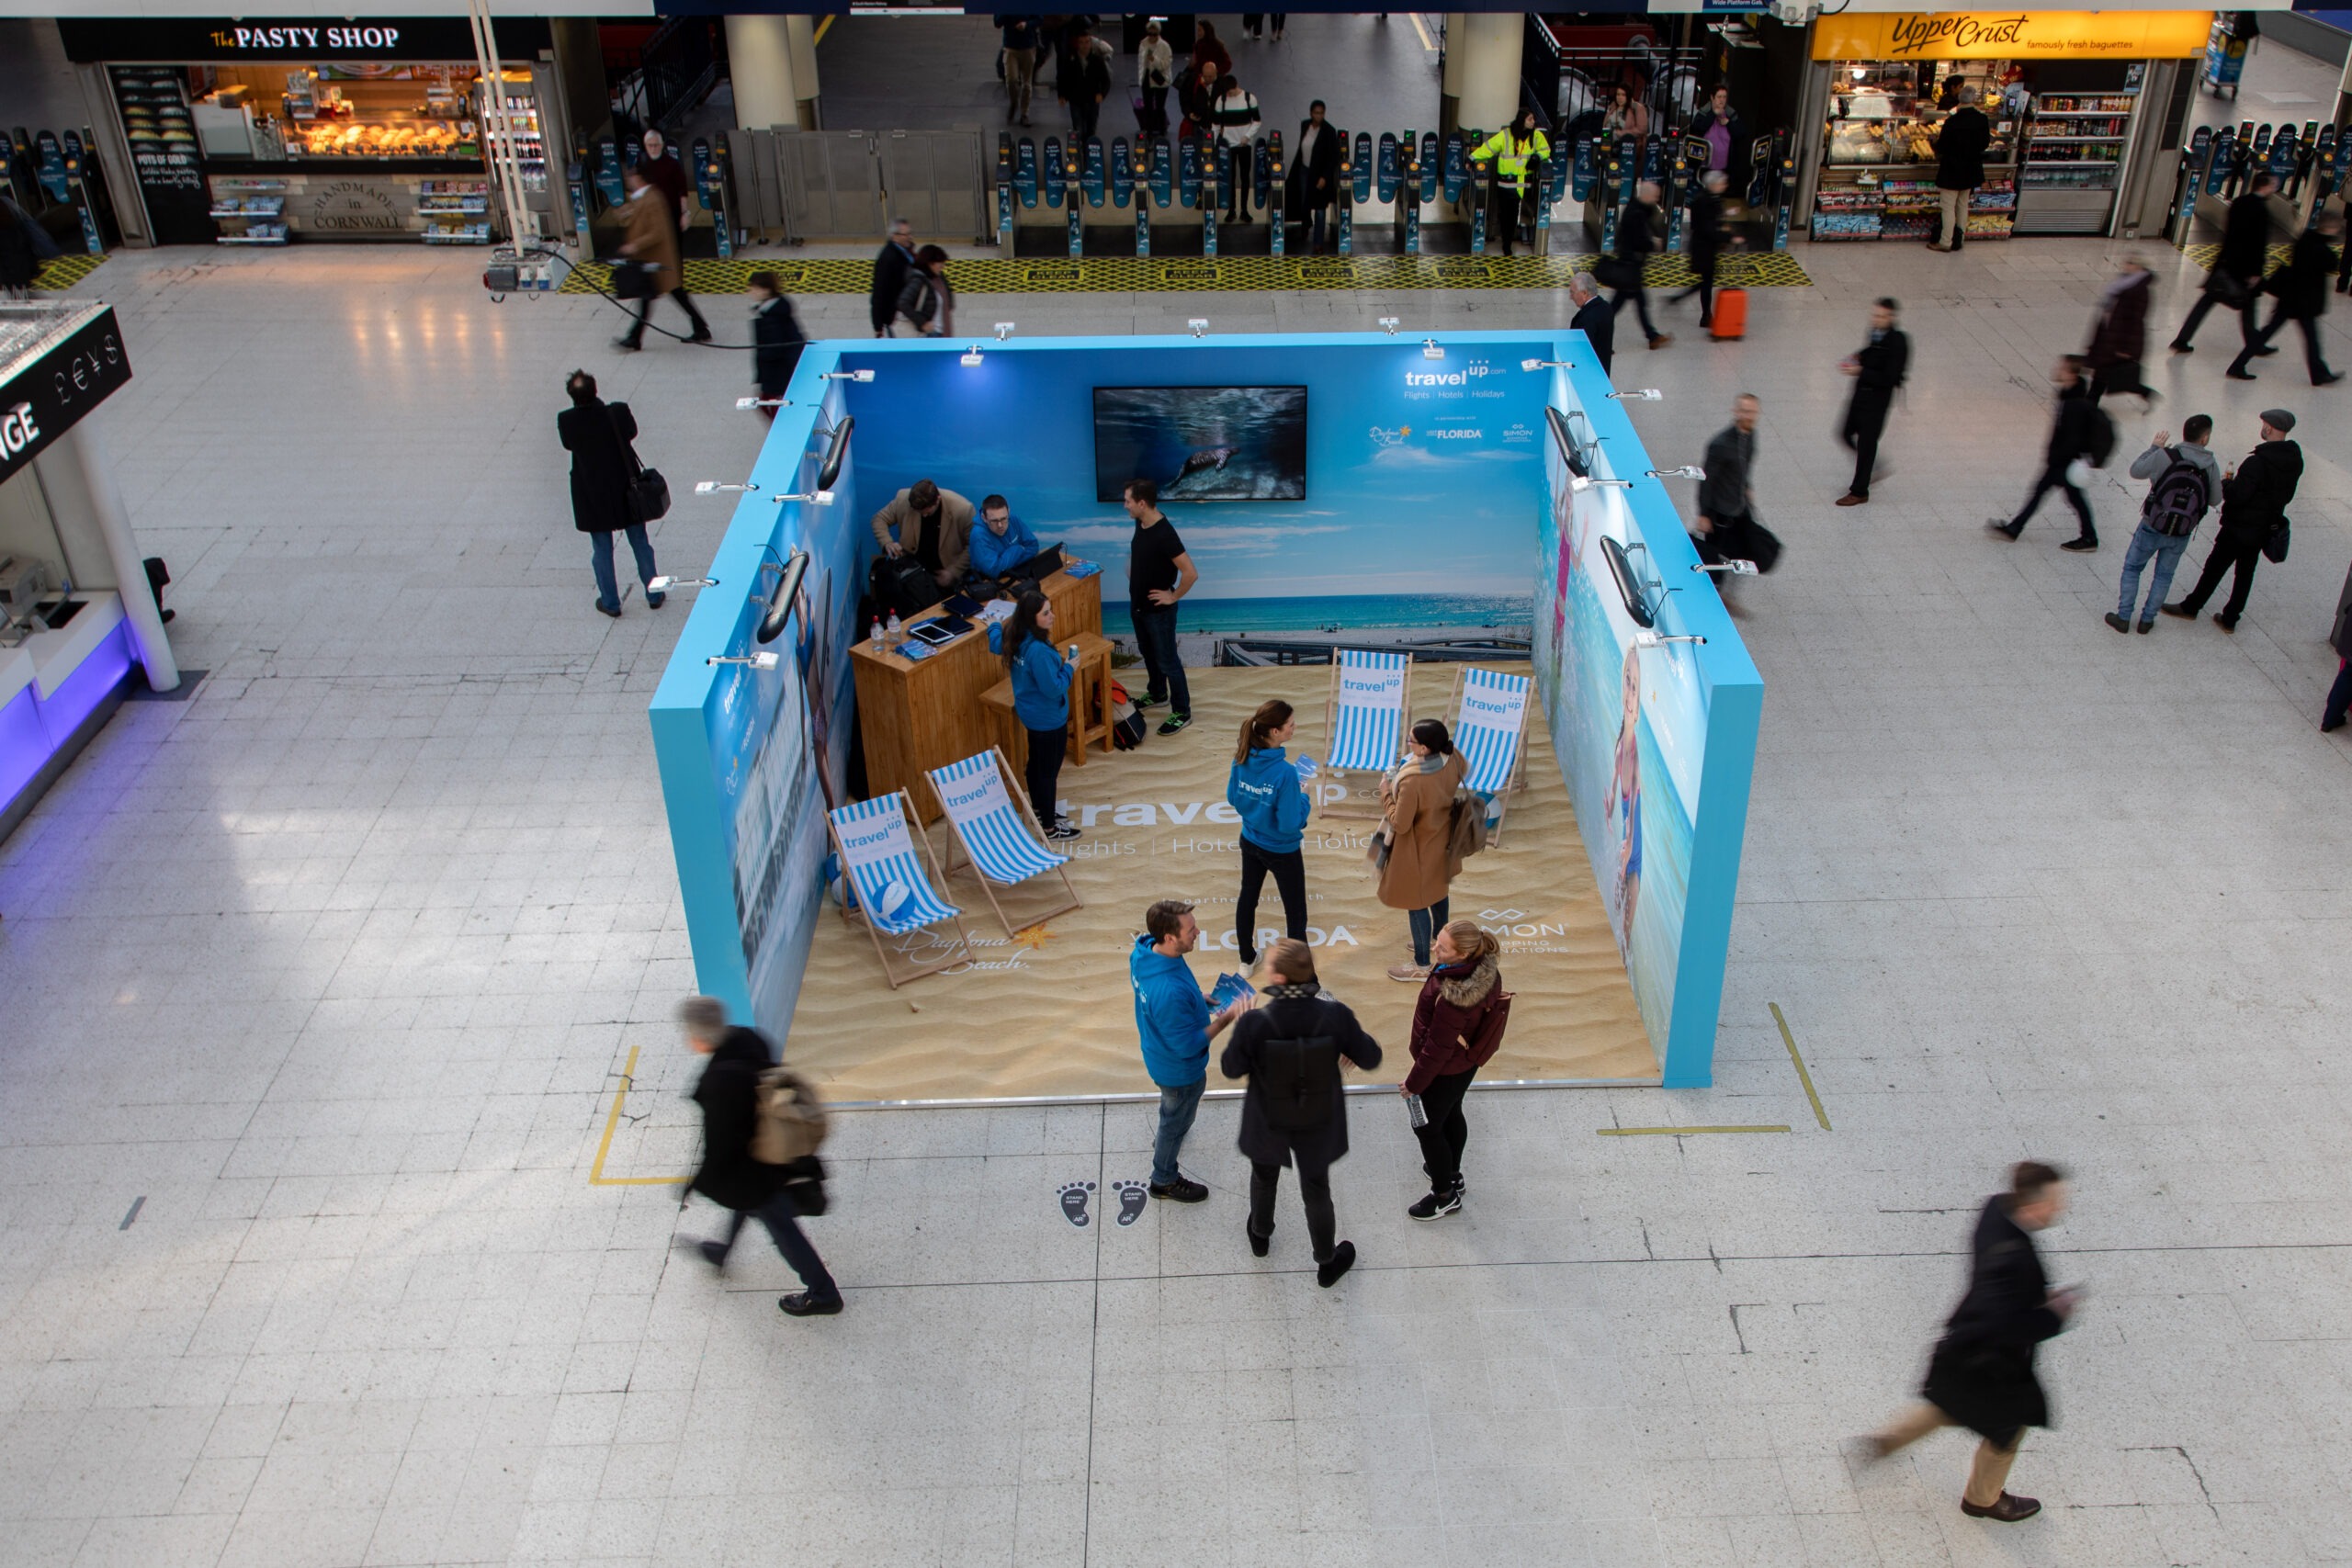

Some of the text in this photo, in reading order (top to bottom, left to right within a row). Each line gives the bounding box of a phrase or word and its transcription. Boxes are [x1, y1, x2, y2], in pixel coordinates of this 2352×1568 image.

[210, 28, 399, 48] The PASTY SHOP
[1892, 15, 2029, 53] Upper Crust
[2027, 39, 2133, 51] famously fresh baguettes
[314, 182, 394, 209] HANDMADE
[348, 198, 361, 209] in
[314, 216, 403, 229] CORNWALL
[1405, 370, 1466, 386] travel
[1404, 391, 1430, 400] Flights
[1472, 389, 1505, 398] Holidays
[1437, 429, 1482, 439] FLORIDA
[1343, 677, 1399, 693] travel up
[1466, 695, 1521, 714] travel up
[946, 784, 988, 807] travel
[985, 773, 998, 787] up
[1238, 780, 1262, 795] travel
[1056, 798, 1241, 827] trave
[844, 828, 889, 849] travel
[888, 819, 902, 831] up
[1047, 833, 1374, 859] lights Hote Holid
[1198, 925, 1359, 952] LORDA
[1480, 923, 1566, 937] MON
